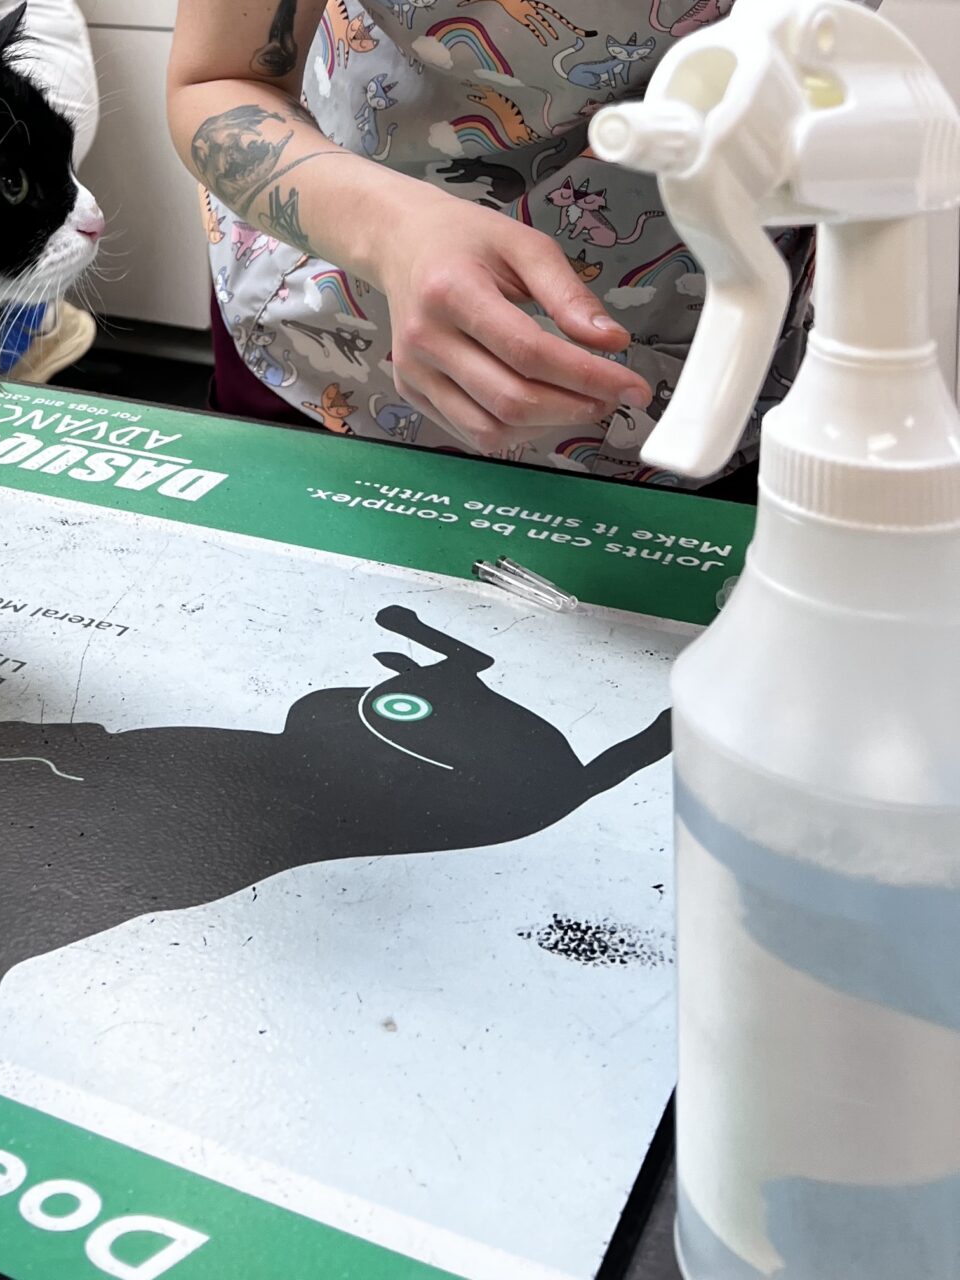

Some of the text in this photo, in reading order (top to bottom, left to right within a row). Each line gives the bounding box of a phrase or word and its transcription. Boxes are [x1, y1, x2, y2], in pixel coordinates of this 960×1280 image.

[34, 396, 66, 411] and
[68, 402, 110, 420] dogs
[112, 407, 142, 422] For
[305, 486, 726, 573] Joints can be complex.
[353, 480, 733, 558] Make it simple with...
[29, 606, 130, 638] Lateral
